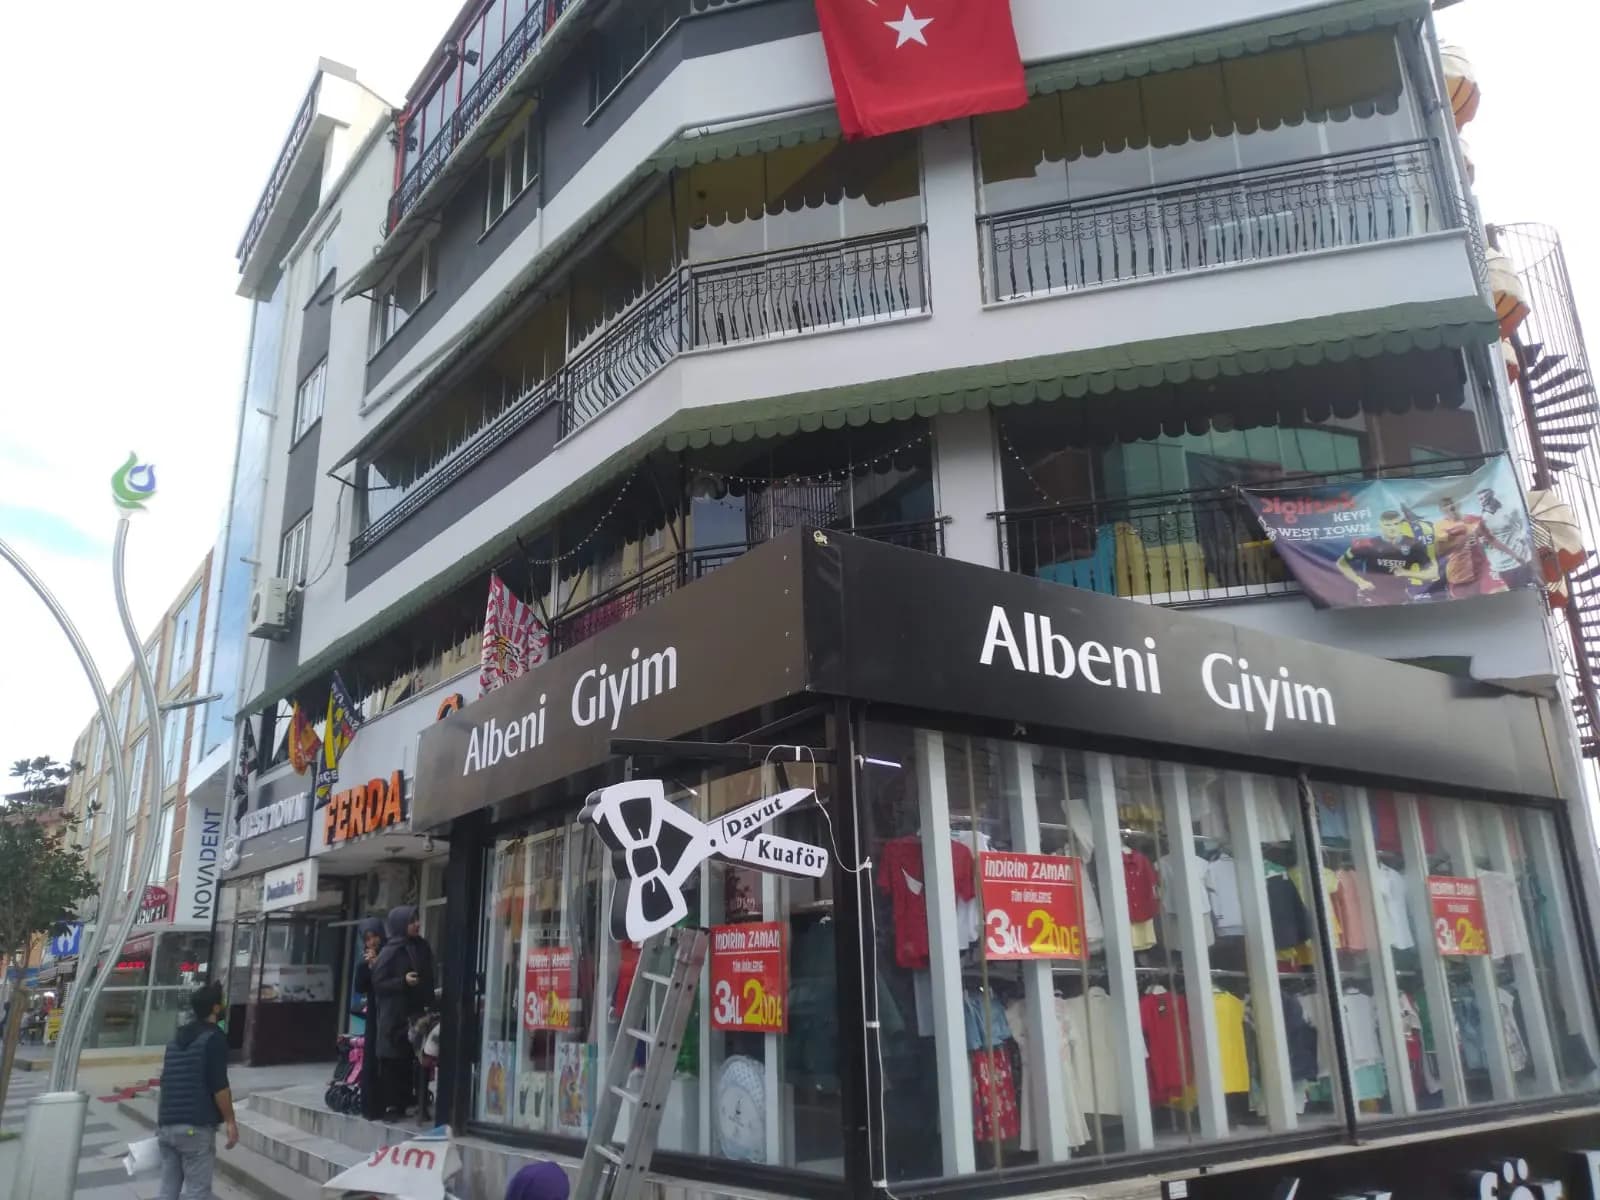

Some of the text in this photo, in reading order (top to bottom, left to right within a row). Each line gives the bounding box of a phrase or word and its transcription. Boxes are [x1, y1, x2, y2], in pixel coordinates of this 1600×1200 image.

[1277, 526, 1320, 538] WEST
[1323, 522, 1370, 537] TOWN
[979, 605, 1336, 731] Albeni Giyim
[463, 646, 677, 776] Albeni Giyim
[323, 769, 404, 845] FERDA
[726, 798, 783, 837] Davut
[192, 808, 221, 919] NOVADENT
[758, 839, 825, 869] Kuaför
